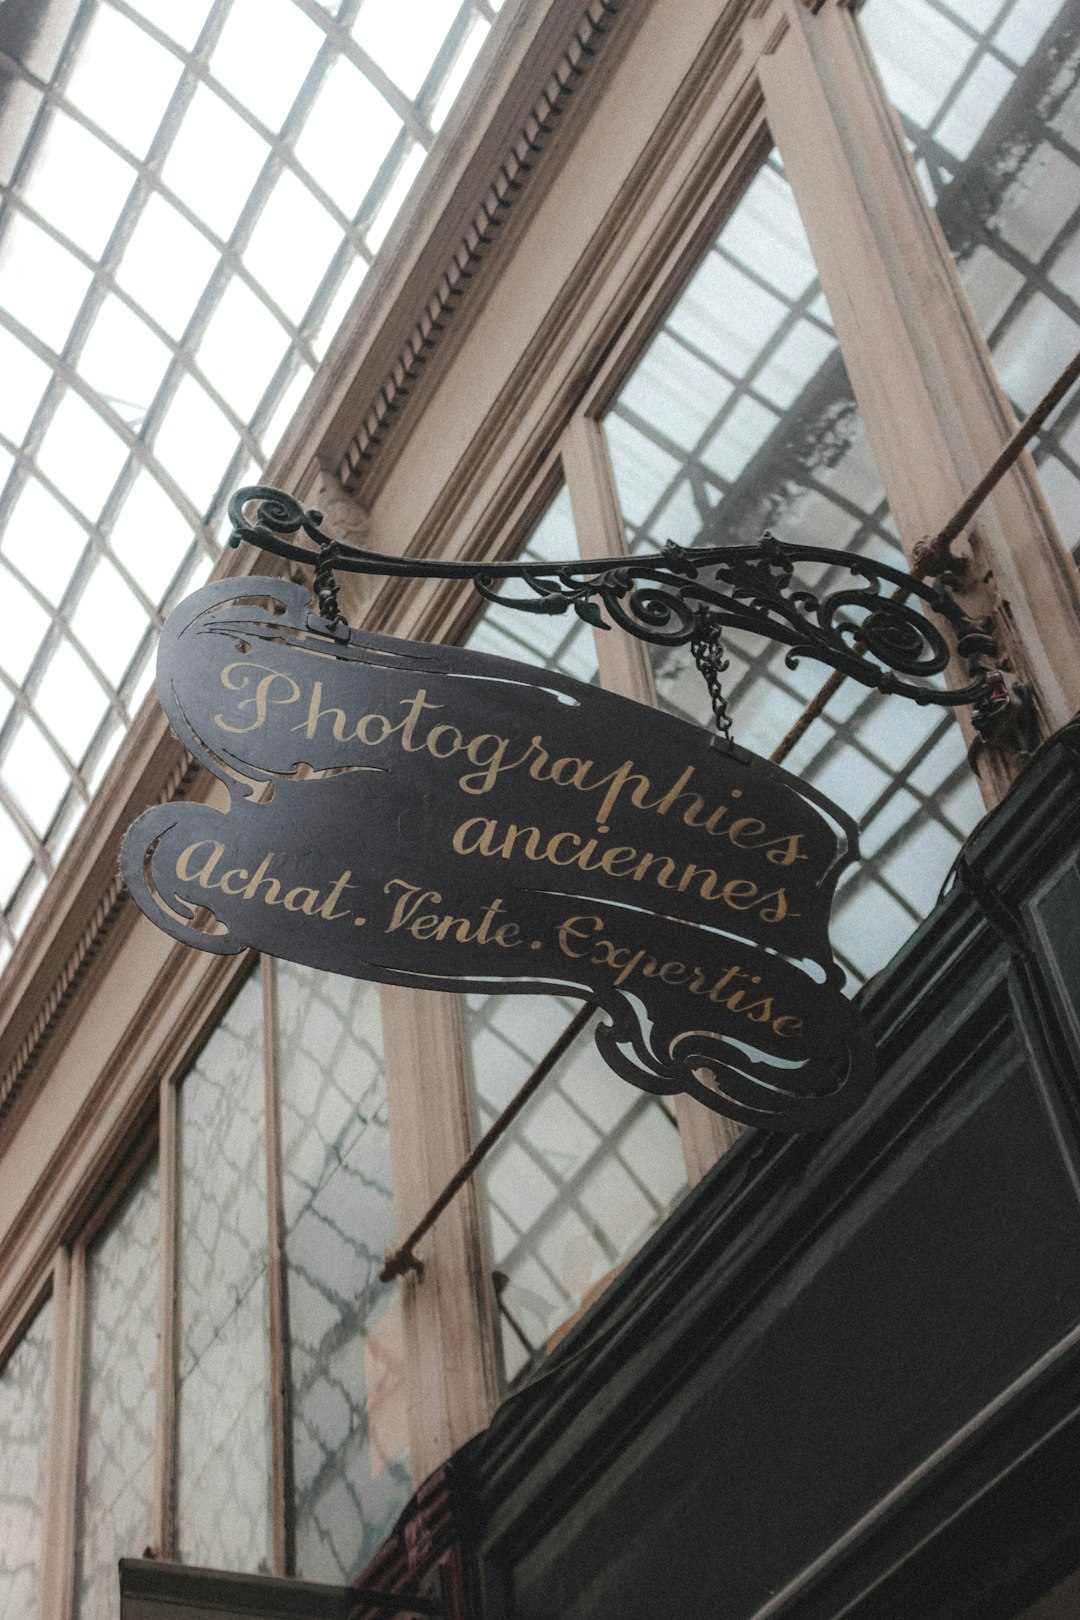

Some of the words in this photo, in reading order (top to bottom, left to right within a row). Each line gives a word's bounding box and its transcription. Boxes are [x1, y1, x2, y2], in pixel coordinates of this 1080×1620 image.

[214, 662, 808, 866] Photographies
[452, 817, 796, 923] anciennes
[558, 916, 803, 1037] Expertise
